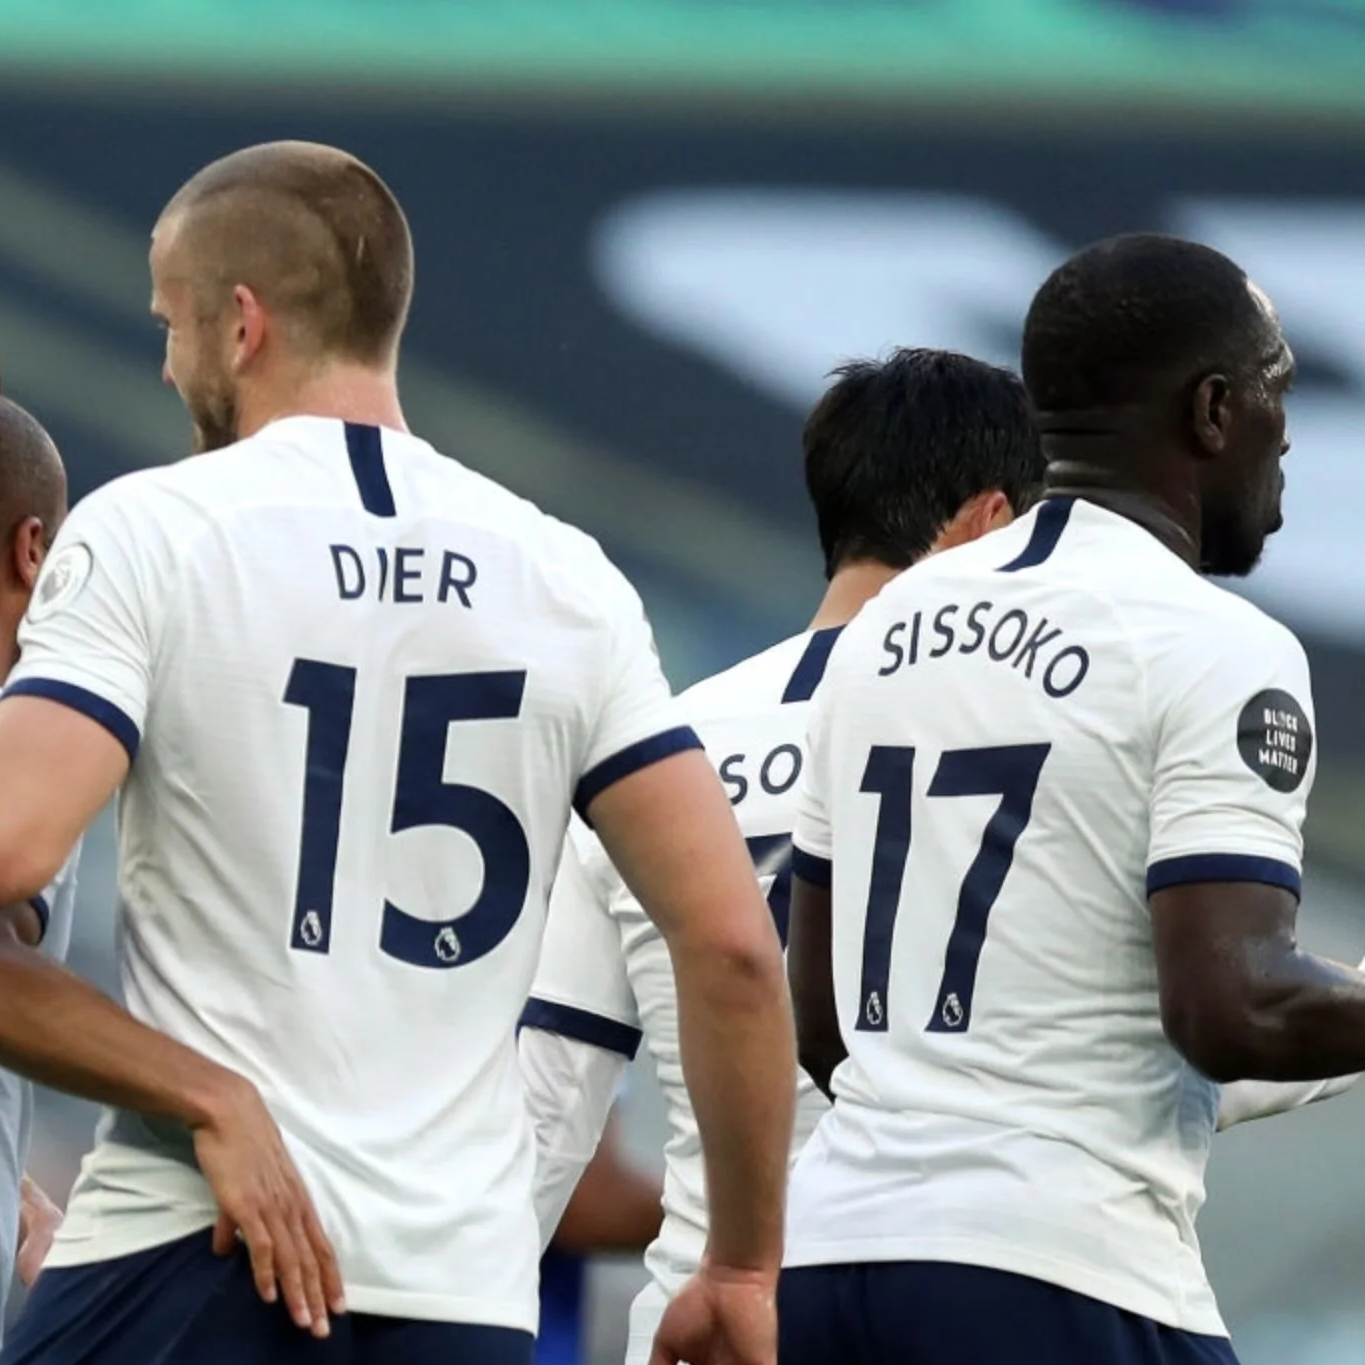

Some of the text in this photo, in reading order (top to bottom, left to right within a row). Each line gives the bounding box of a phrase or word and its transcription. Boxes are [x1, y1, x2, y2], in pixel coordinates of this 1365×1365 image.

[329, 544, 477, 608] DIER
[878, 601, 1090, 699] SISSOKO
[1258, 749, 1297, 774] MATTER
[1266, 729, 1296, 752] LIVES
[282, 657, 530, 969] 15
[855, 743, 1051, 1032] 17
